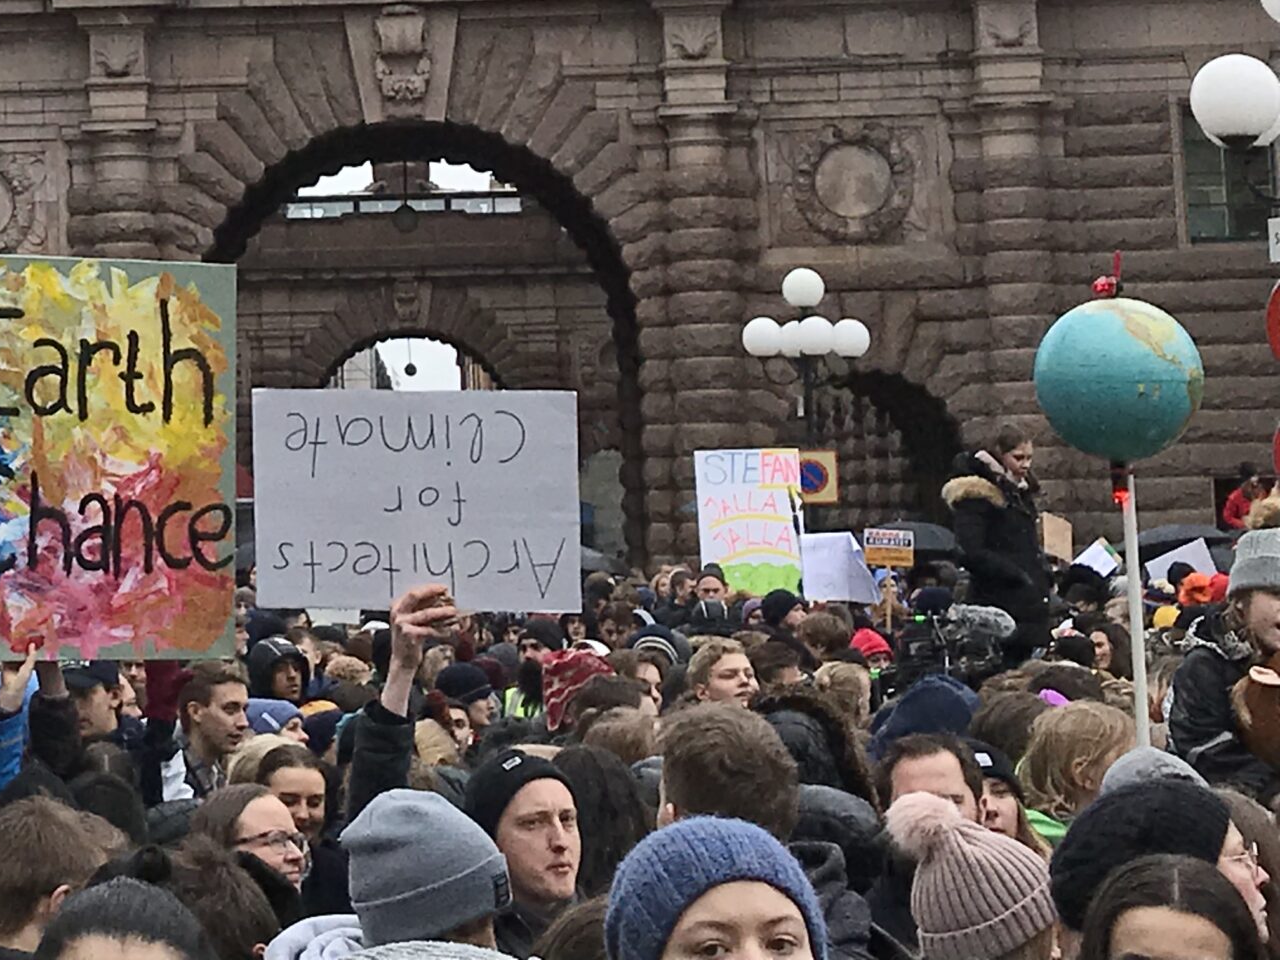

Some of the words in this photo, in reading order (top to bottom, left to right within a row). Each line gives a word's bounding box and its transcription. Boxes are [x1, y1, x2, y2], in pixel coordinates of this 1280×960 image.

[284, 409, 526, 478] Climate
[704, 451, 799, 485] STEFAN
[383, 480, 467, 527] for
[272, 536, 566, 599] Architects
